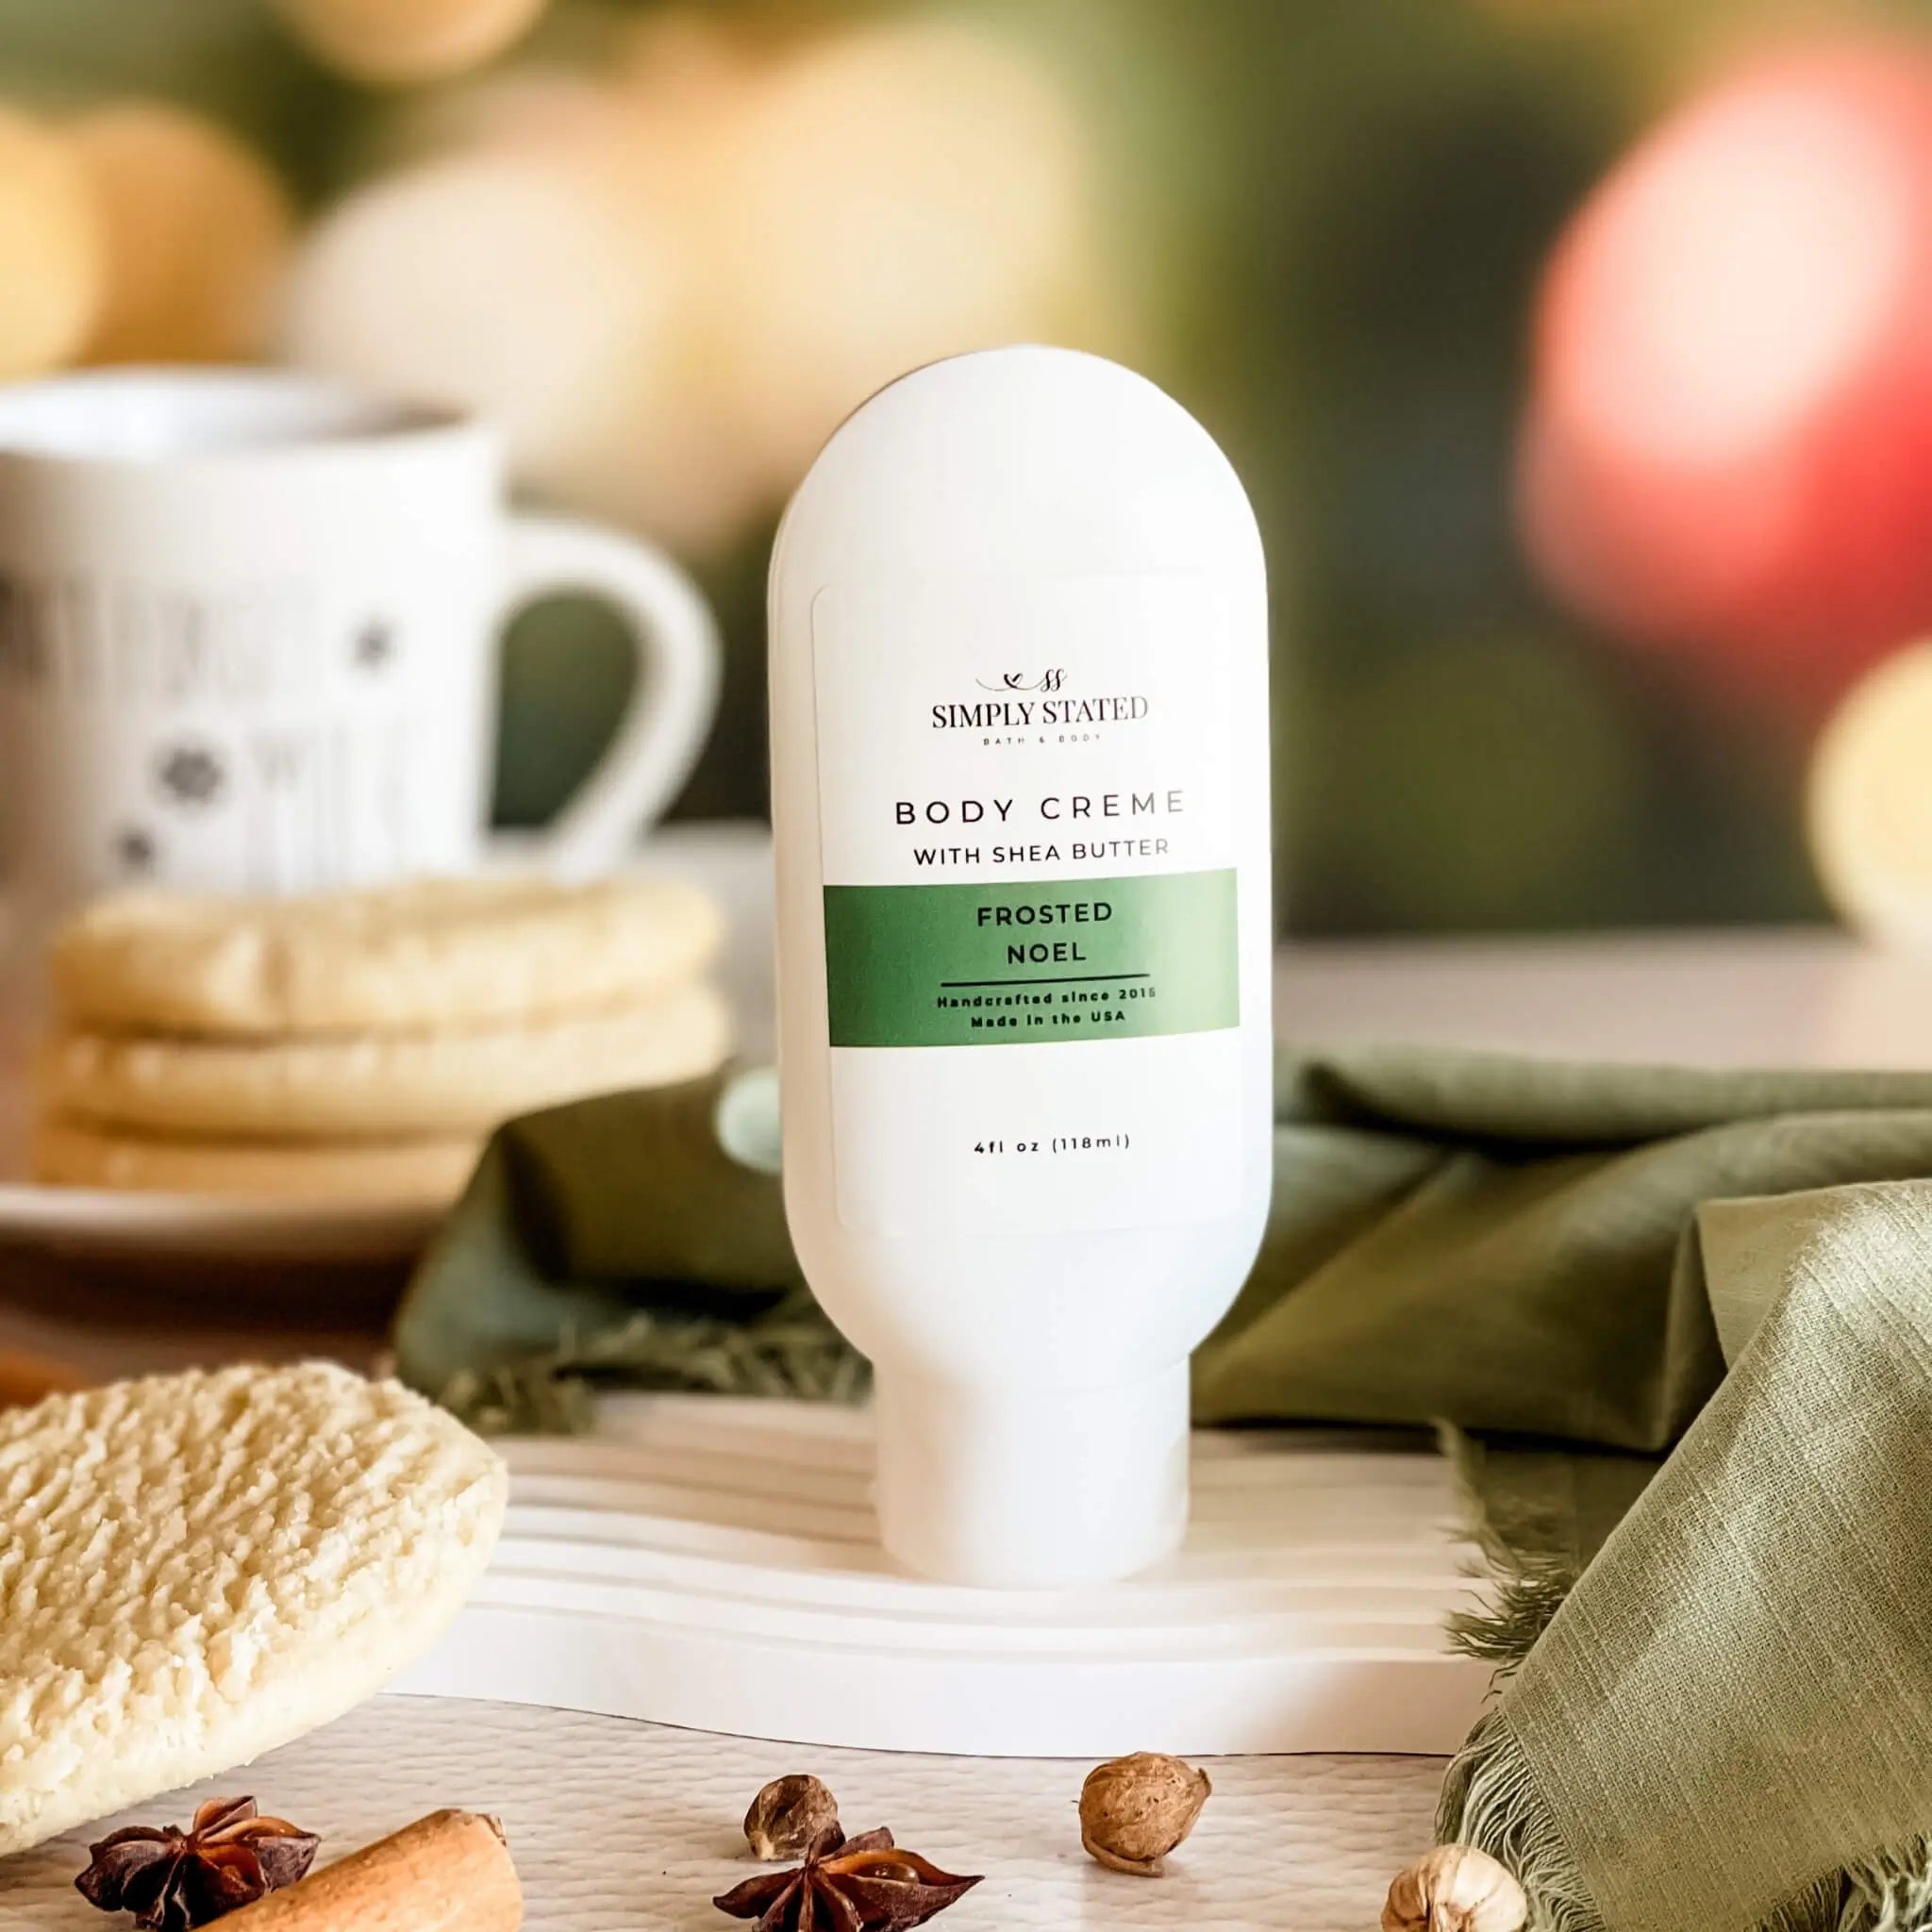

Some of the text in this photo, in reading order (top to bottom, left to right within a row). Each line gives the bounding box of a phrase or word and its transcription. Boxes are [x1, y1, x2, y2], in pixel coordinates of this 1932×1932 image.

[932, 695, 1149, 729] SIMPLY STATED
[983, 737, 1025, 746] BATH
[895, 790, 1185, 825] BODY CREME
[913, 838, 1170, 867] WITH SHEA BUTTER
[977, 902, 1112, 927] FROSTED
[1007, 941, 1088, 966] NOEL
[937, 992, 1054, 1008] Handcrafted
[1061, 991, 1109, 1005] since
[971, 1009, 1126, 1029] Made in the USA
[974, 1133, 1131, 1155] 4fl oz (118ml)
